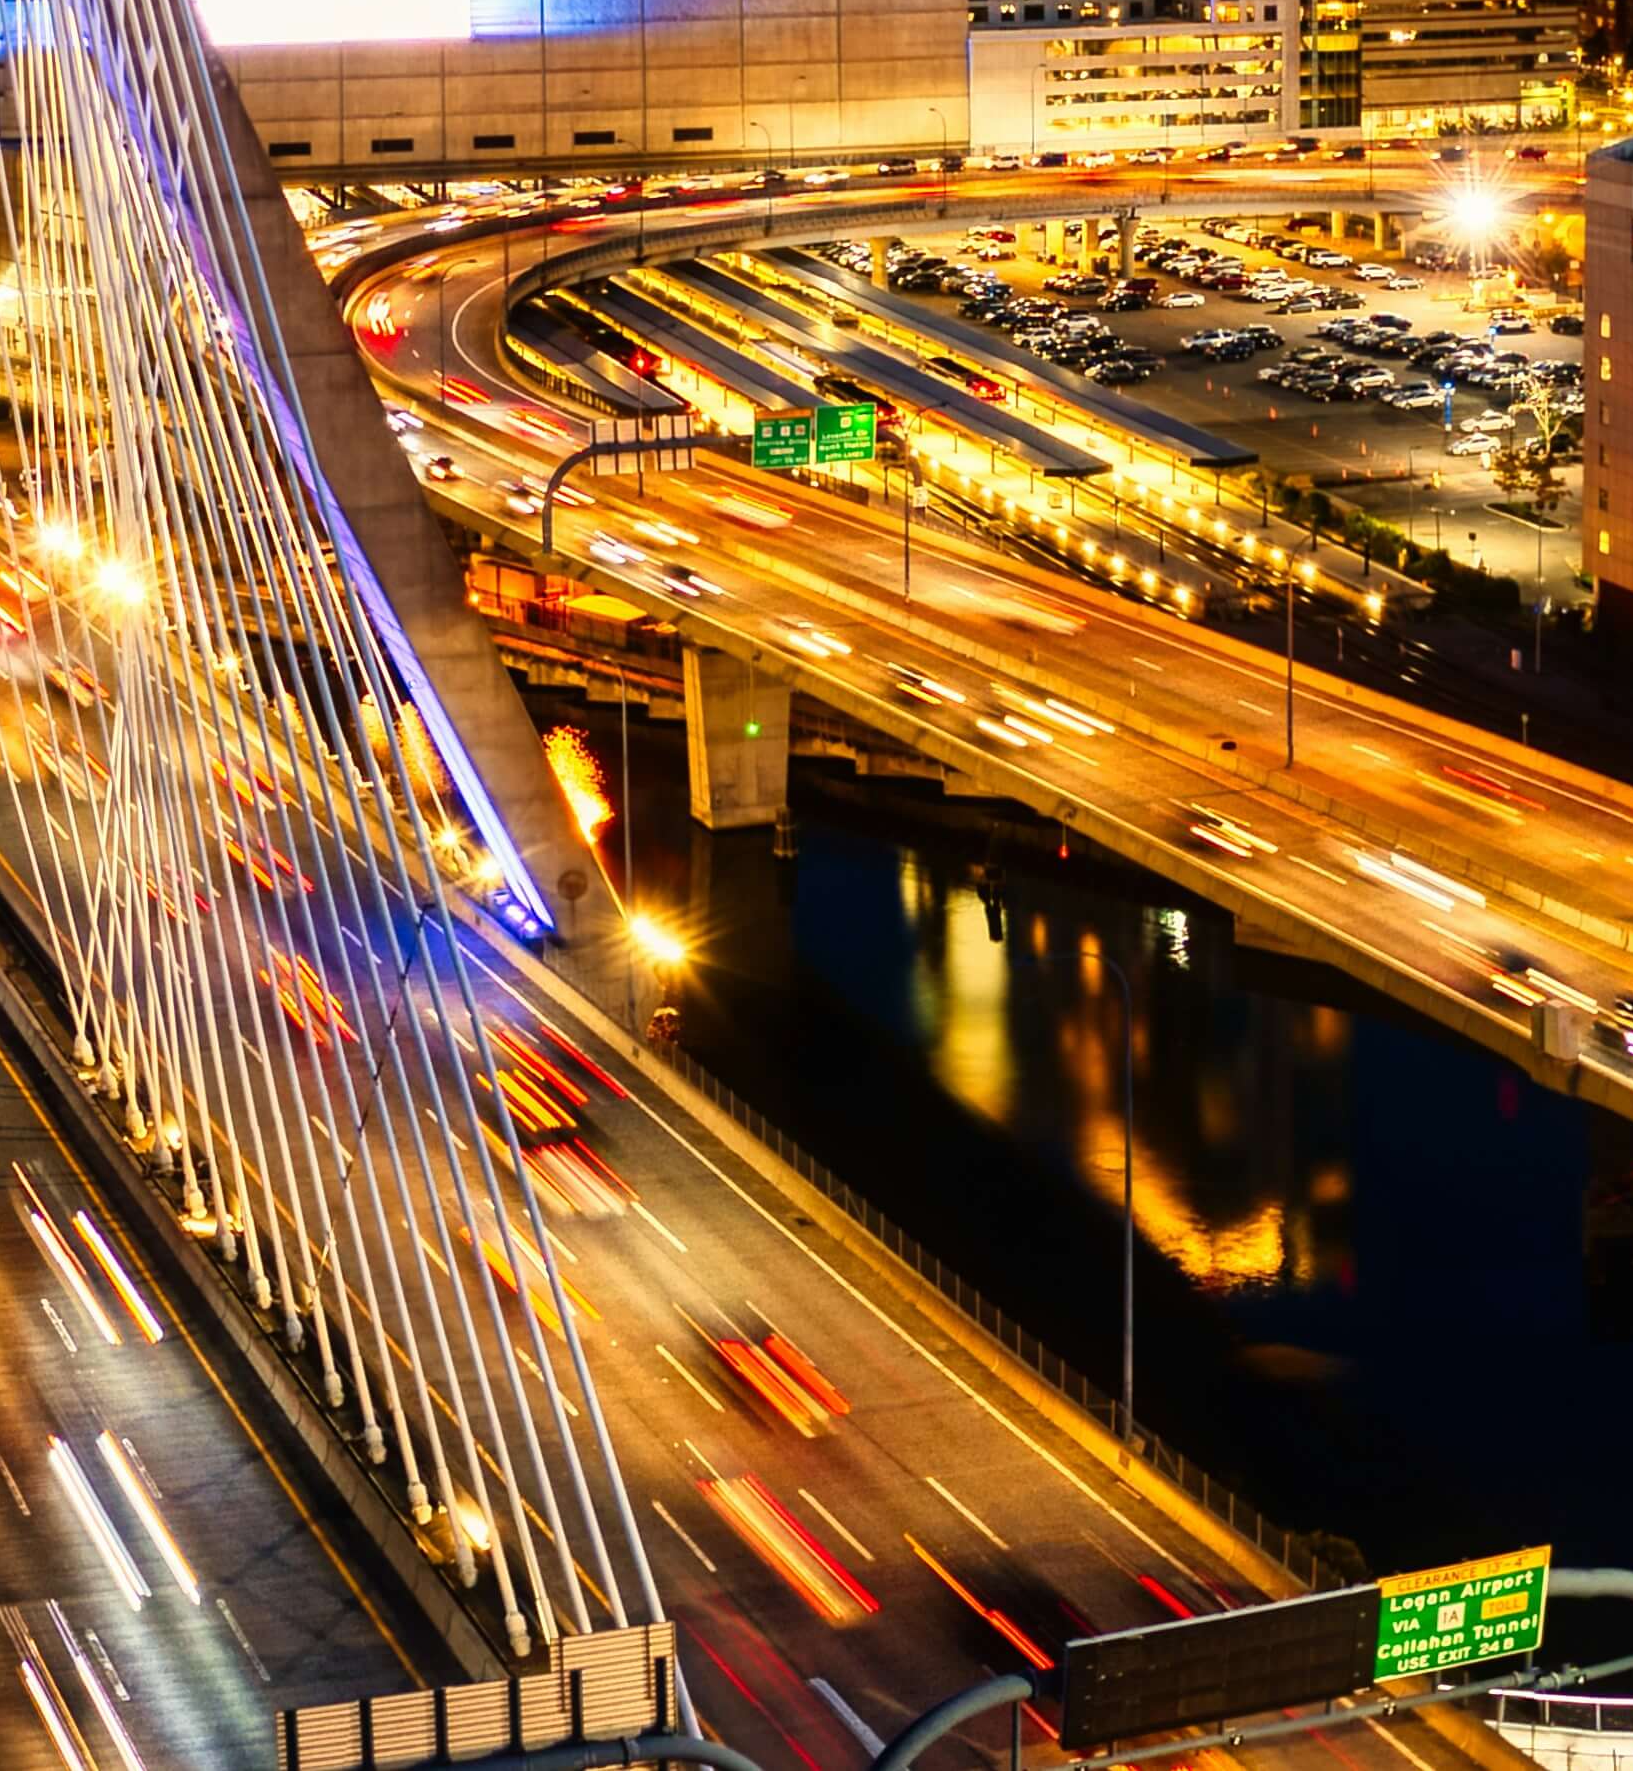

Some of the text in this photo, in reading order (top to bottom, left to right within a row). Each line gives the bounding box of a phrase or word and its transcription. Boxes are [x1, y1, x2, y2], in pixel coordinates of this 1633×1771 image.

[1390, 1570, 1534, 1612] Logan Airport
[1397, 1566, 1478, 1593] CLEARANCE
[1392, 1596, 1522, 1634] VIA 1A TOLL
[1377, 1614, 1538, 1659] Callahan Tunnel
[1397, 1654, 1430, 1672] USE
[1437, 1646, 1472, 1664] EXIT
